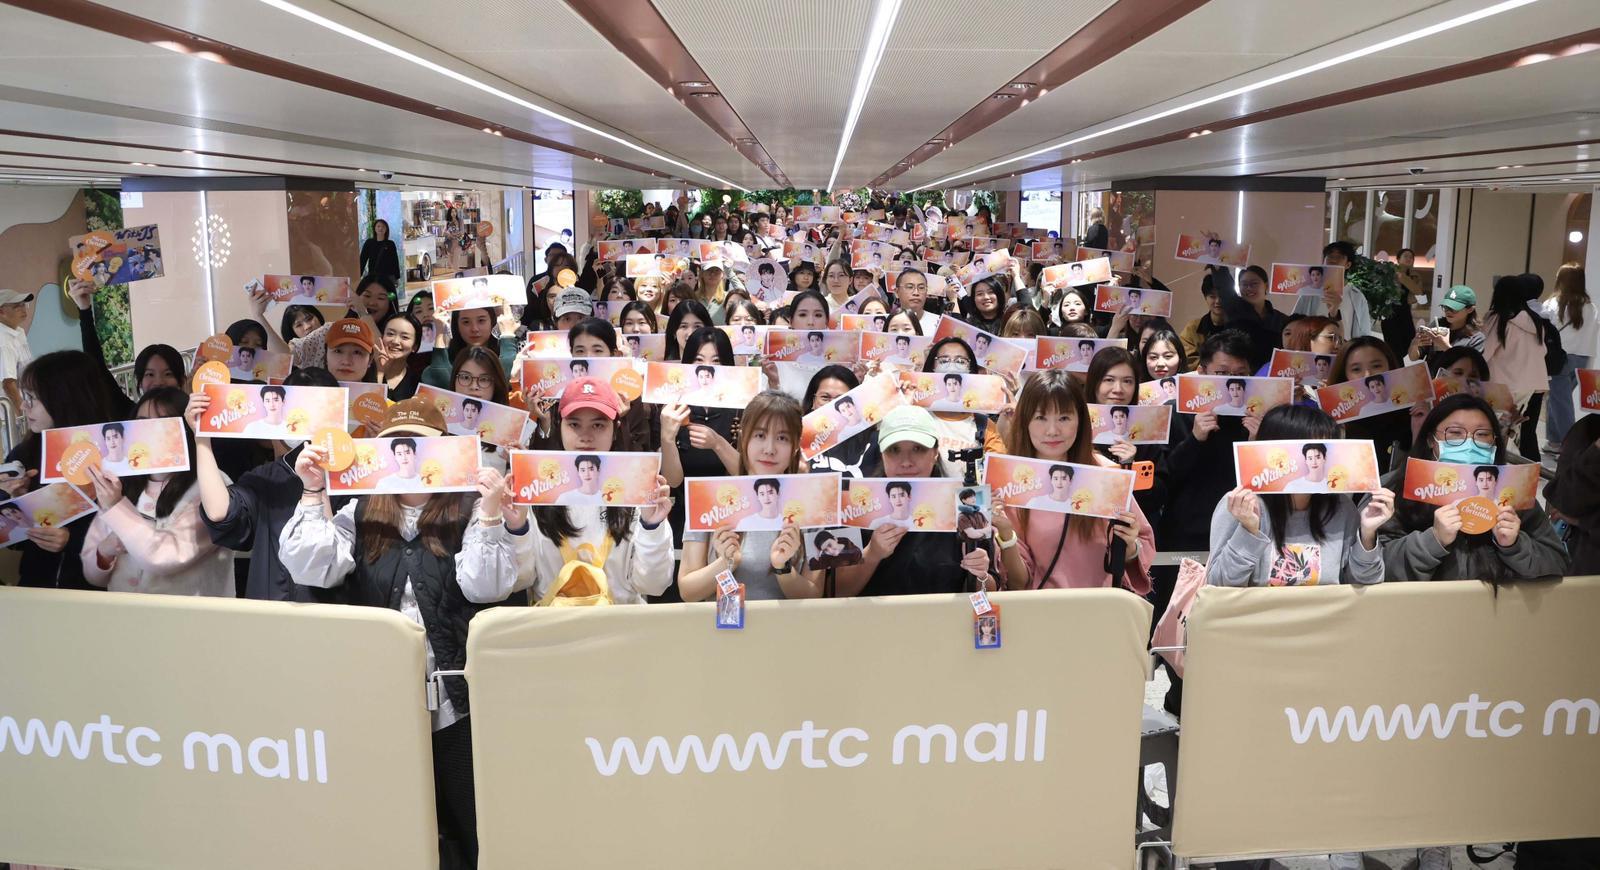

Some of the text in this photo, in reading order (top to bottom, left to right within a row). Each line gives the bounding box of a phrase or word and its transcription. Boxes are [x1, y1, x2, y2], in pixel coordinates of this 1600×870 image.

[583, 384, 595, 394] R
[183, 727, 328, 784] mall
[892, 709, 1048, 765] mall
